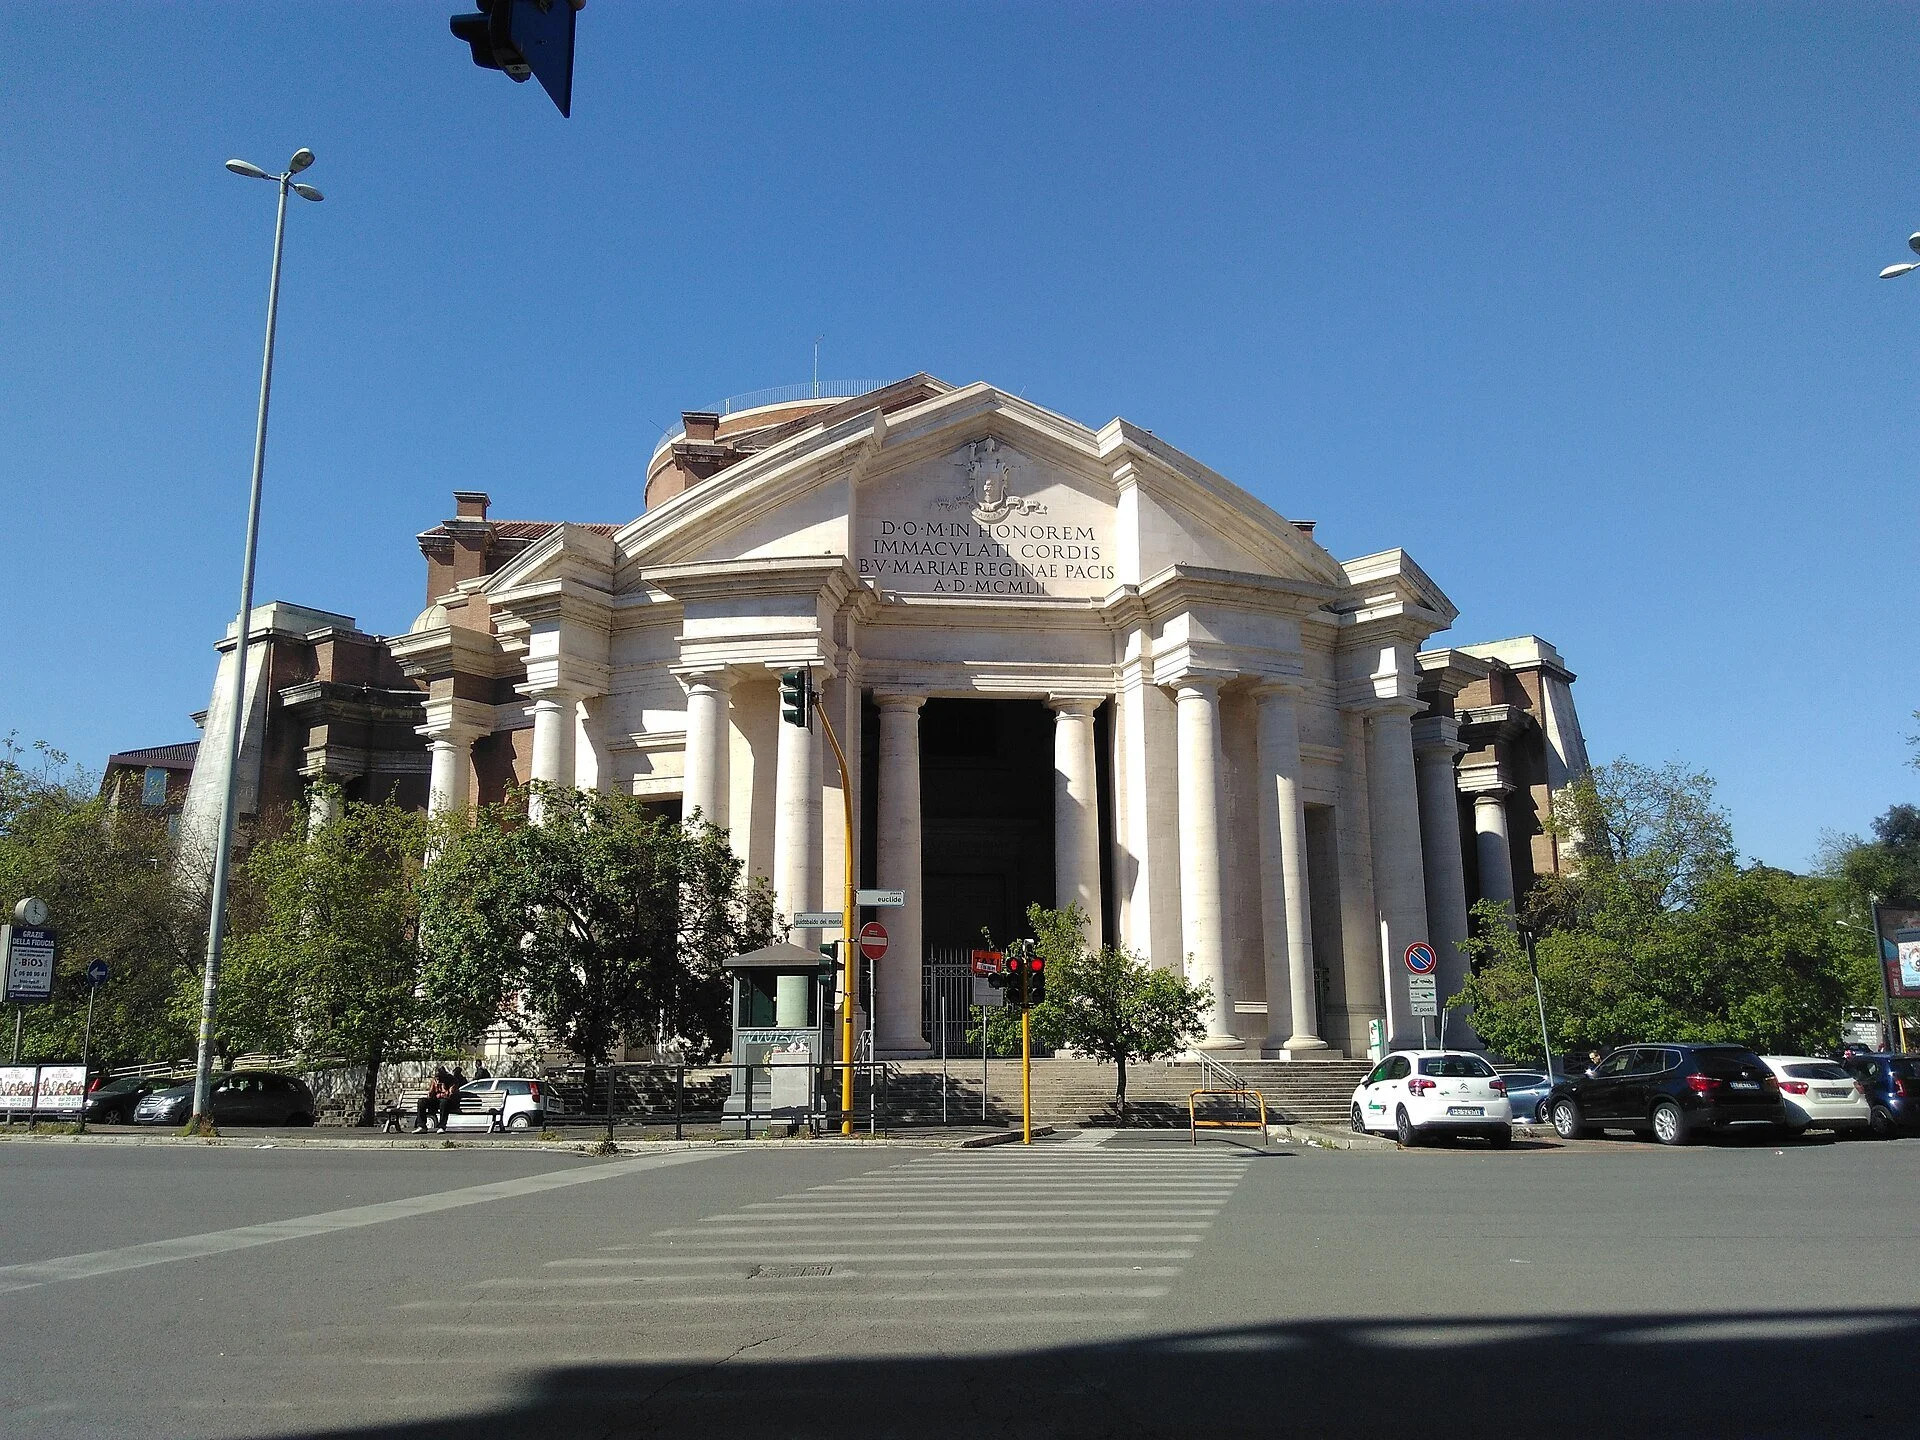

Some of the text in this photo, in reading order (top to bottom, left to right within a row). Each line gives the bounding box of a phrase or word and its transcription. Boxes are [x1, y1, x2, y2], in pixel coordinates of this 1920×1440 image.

[978, 524, 1096, 541] HONOREM
[873, 539, 1100, 560] IMMACVLATI CORDIS
[974, 562, 1058, 578] REGINAE
[1065, 564, 1115, 580] PACIS
[796, 918, 819, 926] guidobaldo
[22, 930, 45, 938] GRAZIE
[12, 938, 55, 947] DELLA FIDUCIA
